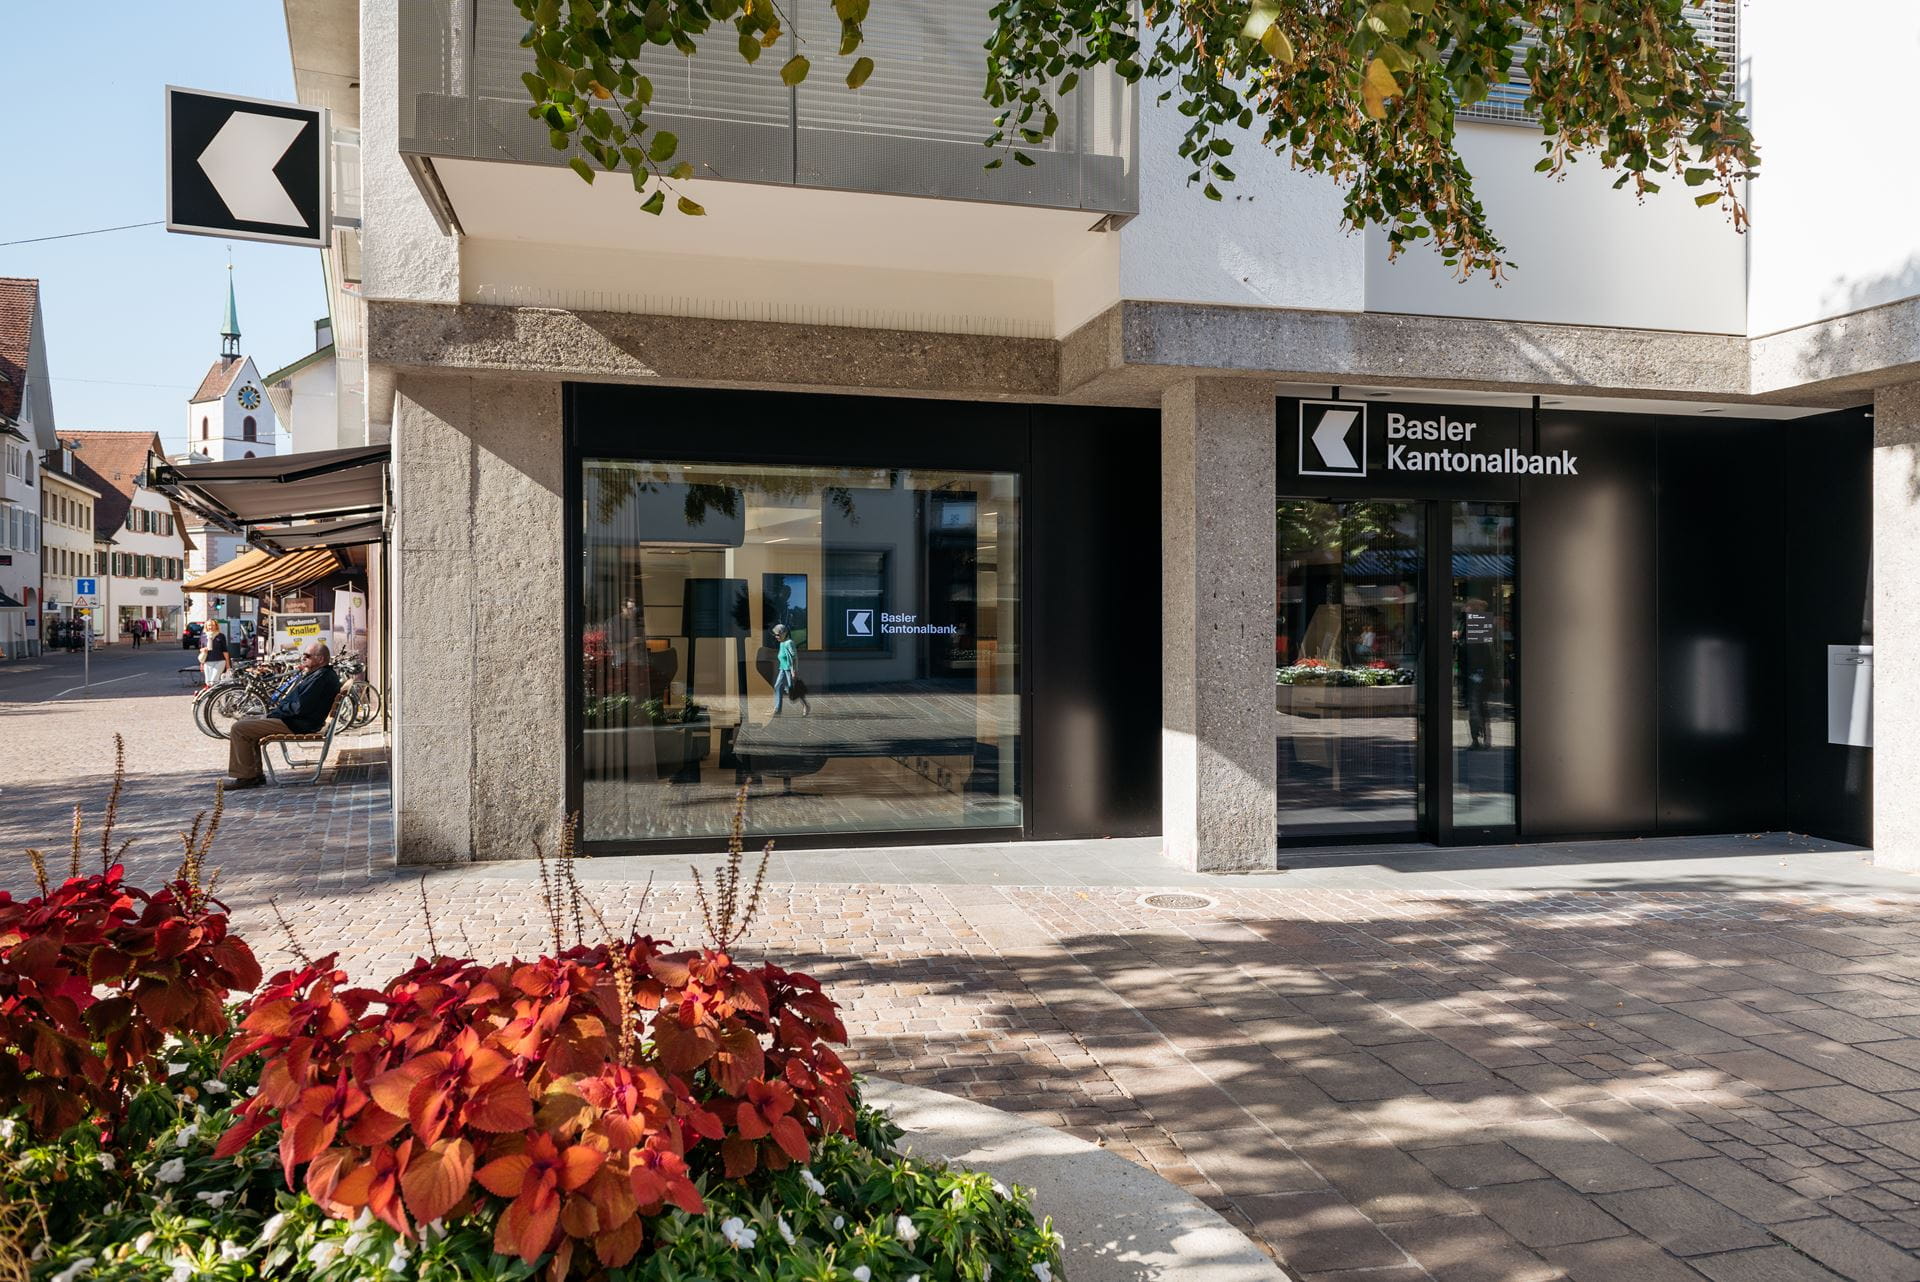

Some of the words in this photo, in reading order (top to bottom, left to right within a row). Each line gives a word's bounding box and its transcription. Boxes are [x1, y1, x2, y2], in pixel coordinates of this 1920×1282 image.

[1387, 413, 1477, 441] Basler
[1387, 444, 1578, 475] Kantonalbank
[881, 612, 916, 622] Basler
[290, 626, 317, 635] Knaller
[881, 624, 957, 634] Kantonalbank
